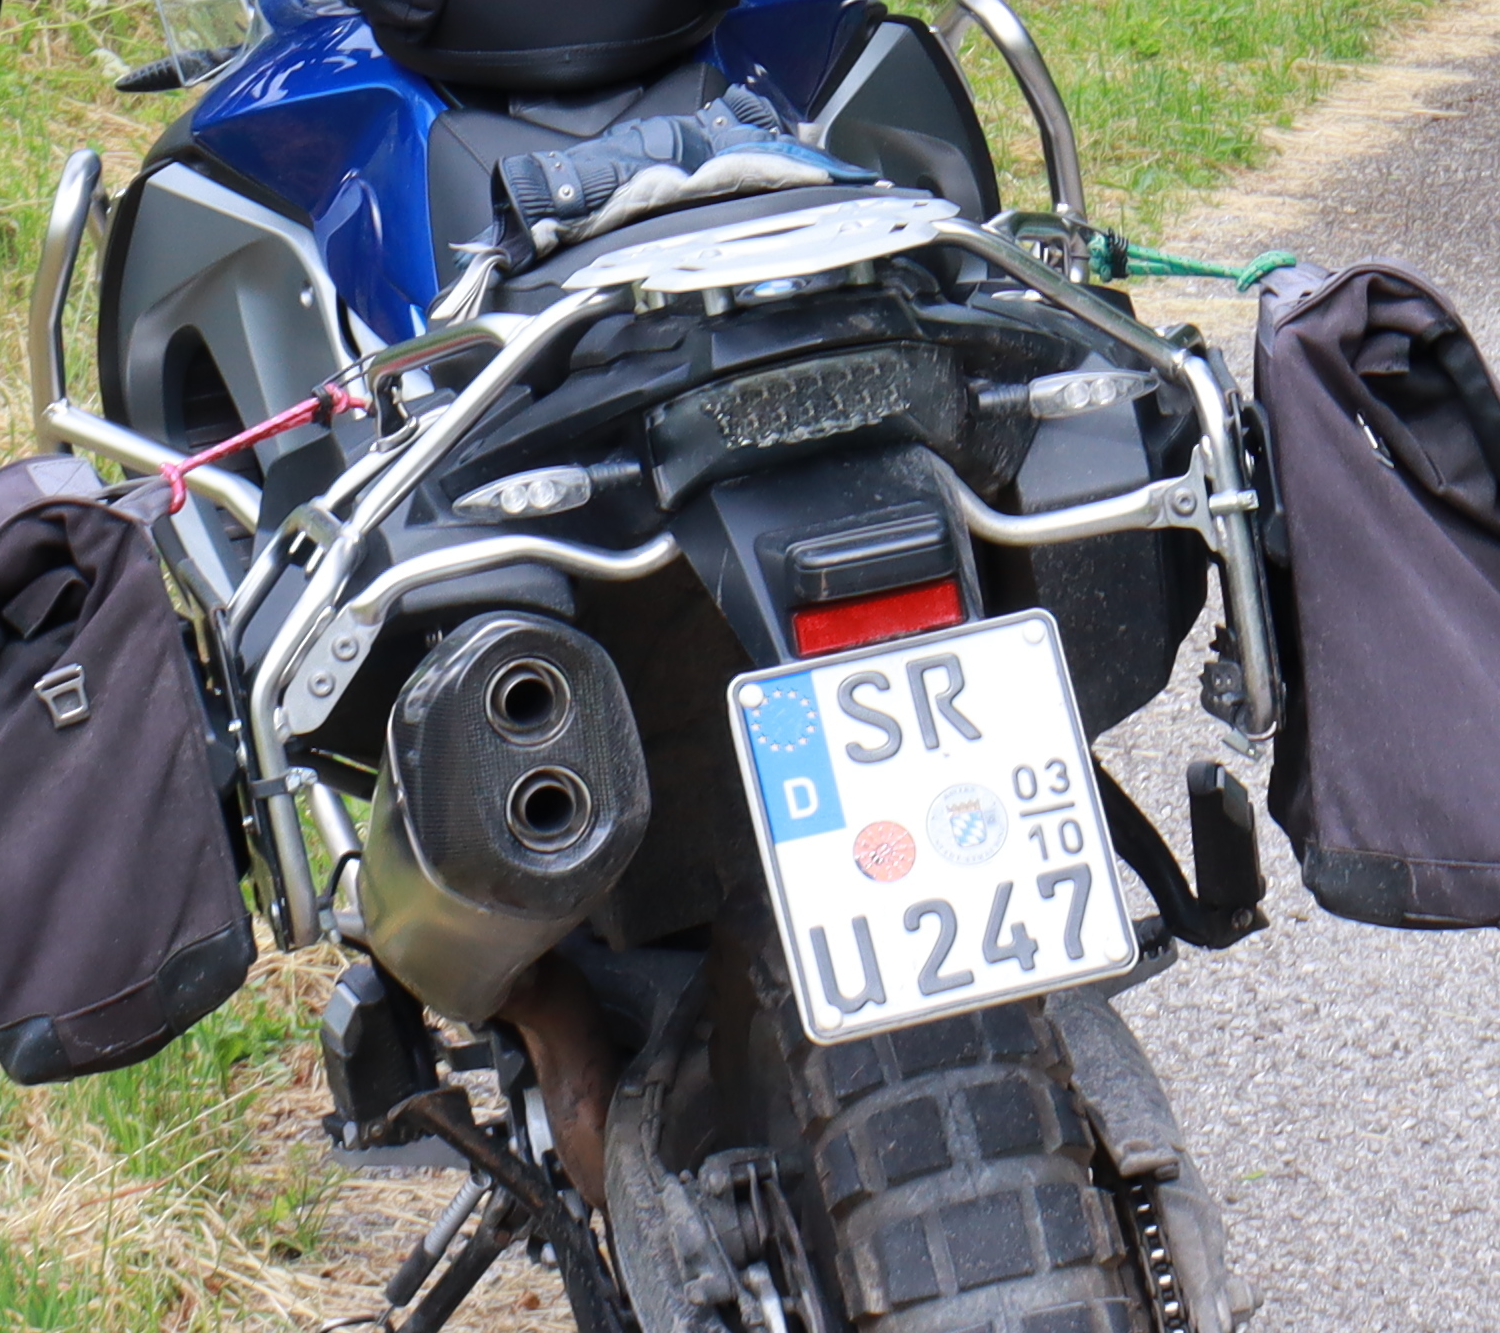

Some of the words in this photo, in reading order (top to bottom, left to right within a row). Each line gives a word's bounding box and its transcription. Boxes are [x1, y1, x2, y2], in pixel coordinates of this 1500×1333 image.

[837, 653, 983, 765] SR
[783, 776, 820, 820] D
[1011, 757, 1071, 801] 03
[1028, 818, 1085, 861] 10
[809, 915, 887, 1015] U
[903, 863, 1093, 998] 247
